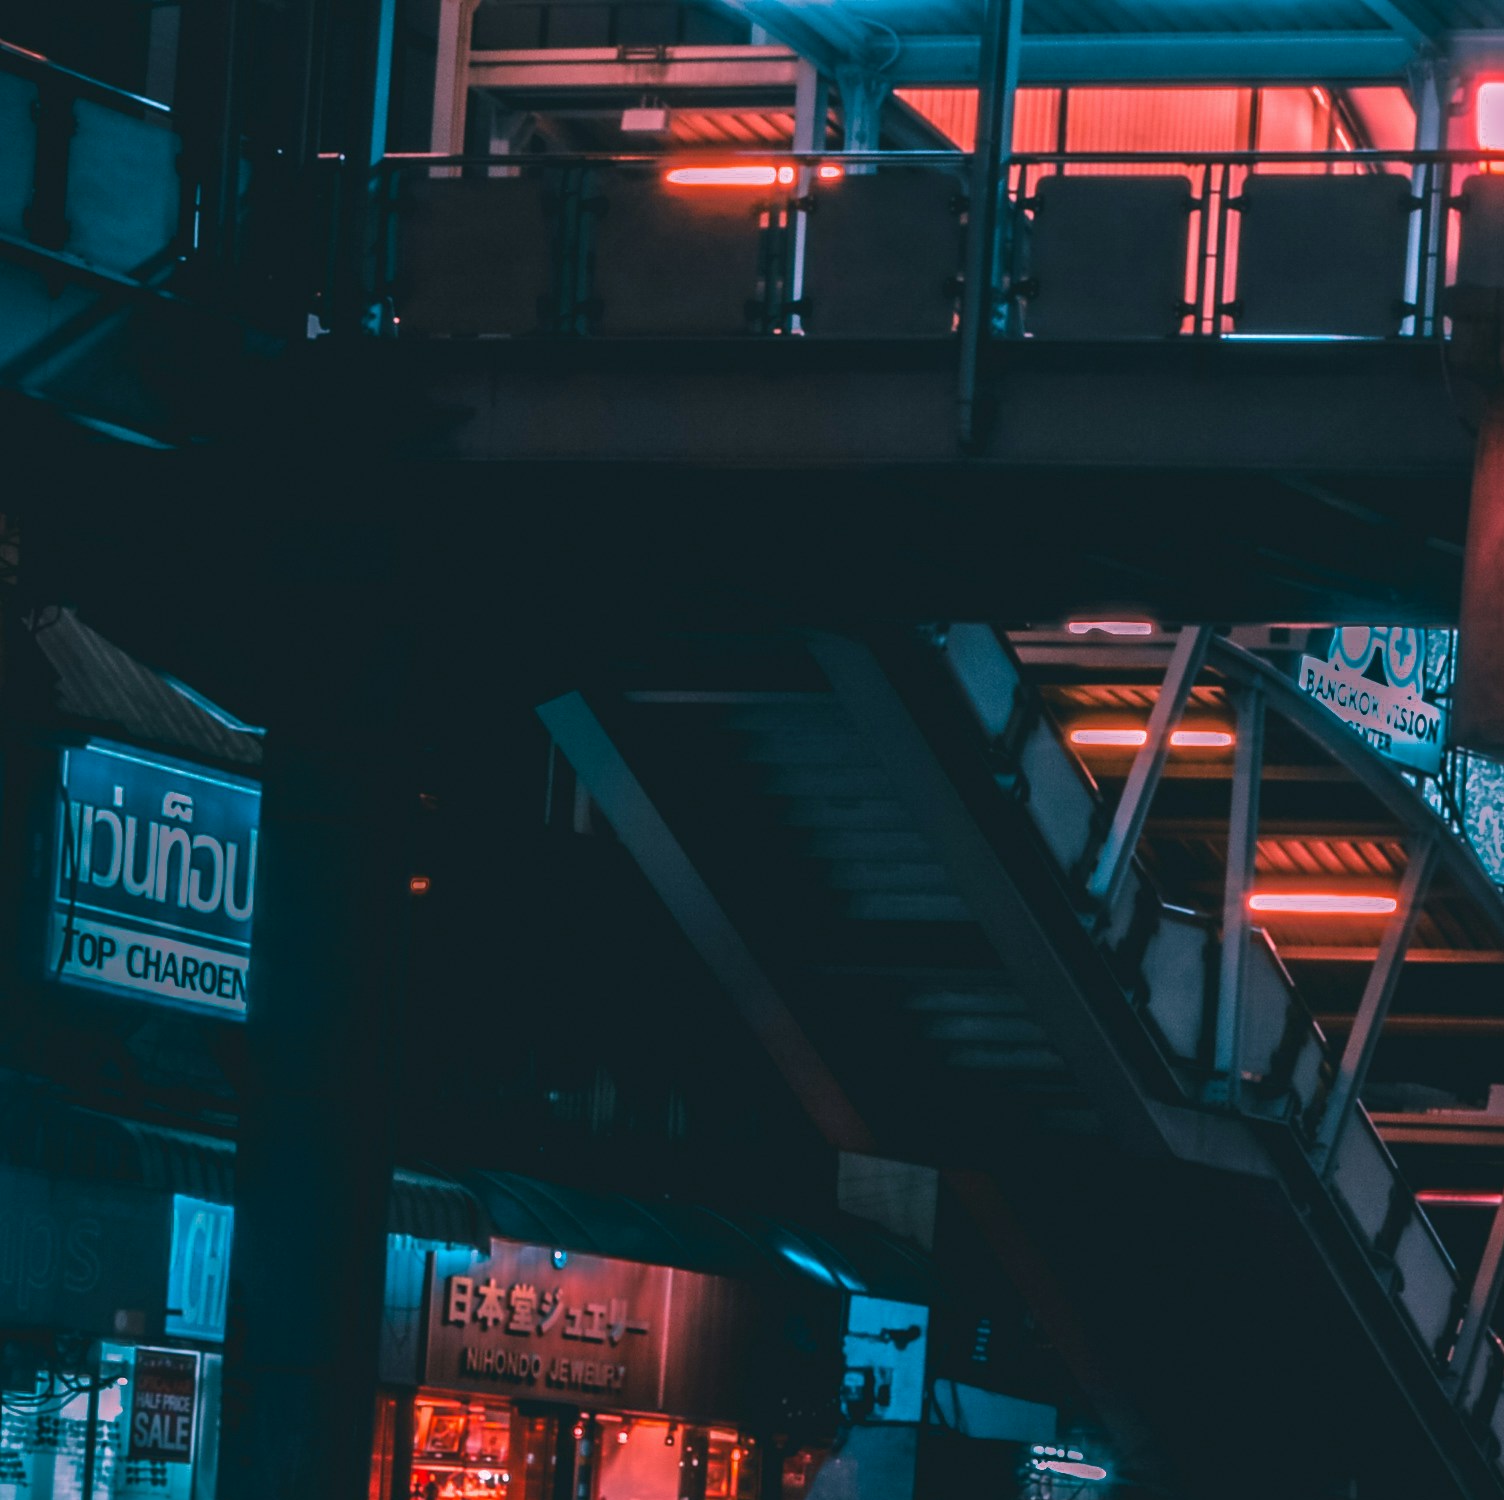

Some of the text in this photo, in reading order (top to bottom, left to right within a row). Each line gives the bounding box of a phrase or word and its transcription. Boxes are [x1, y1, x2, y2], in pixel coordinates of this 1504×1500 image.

[1306, 669, 1441, 744] BANGKOK VISION
[63, 926, 248, 1000] TOP CHAROEN
[446, 1275, 650, 1344] 日本堂ジュエリー
[463, 1347, 626, 1391] NIHONDO JEWELRY
[133, 1411, 190, 1451] SALE
